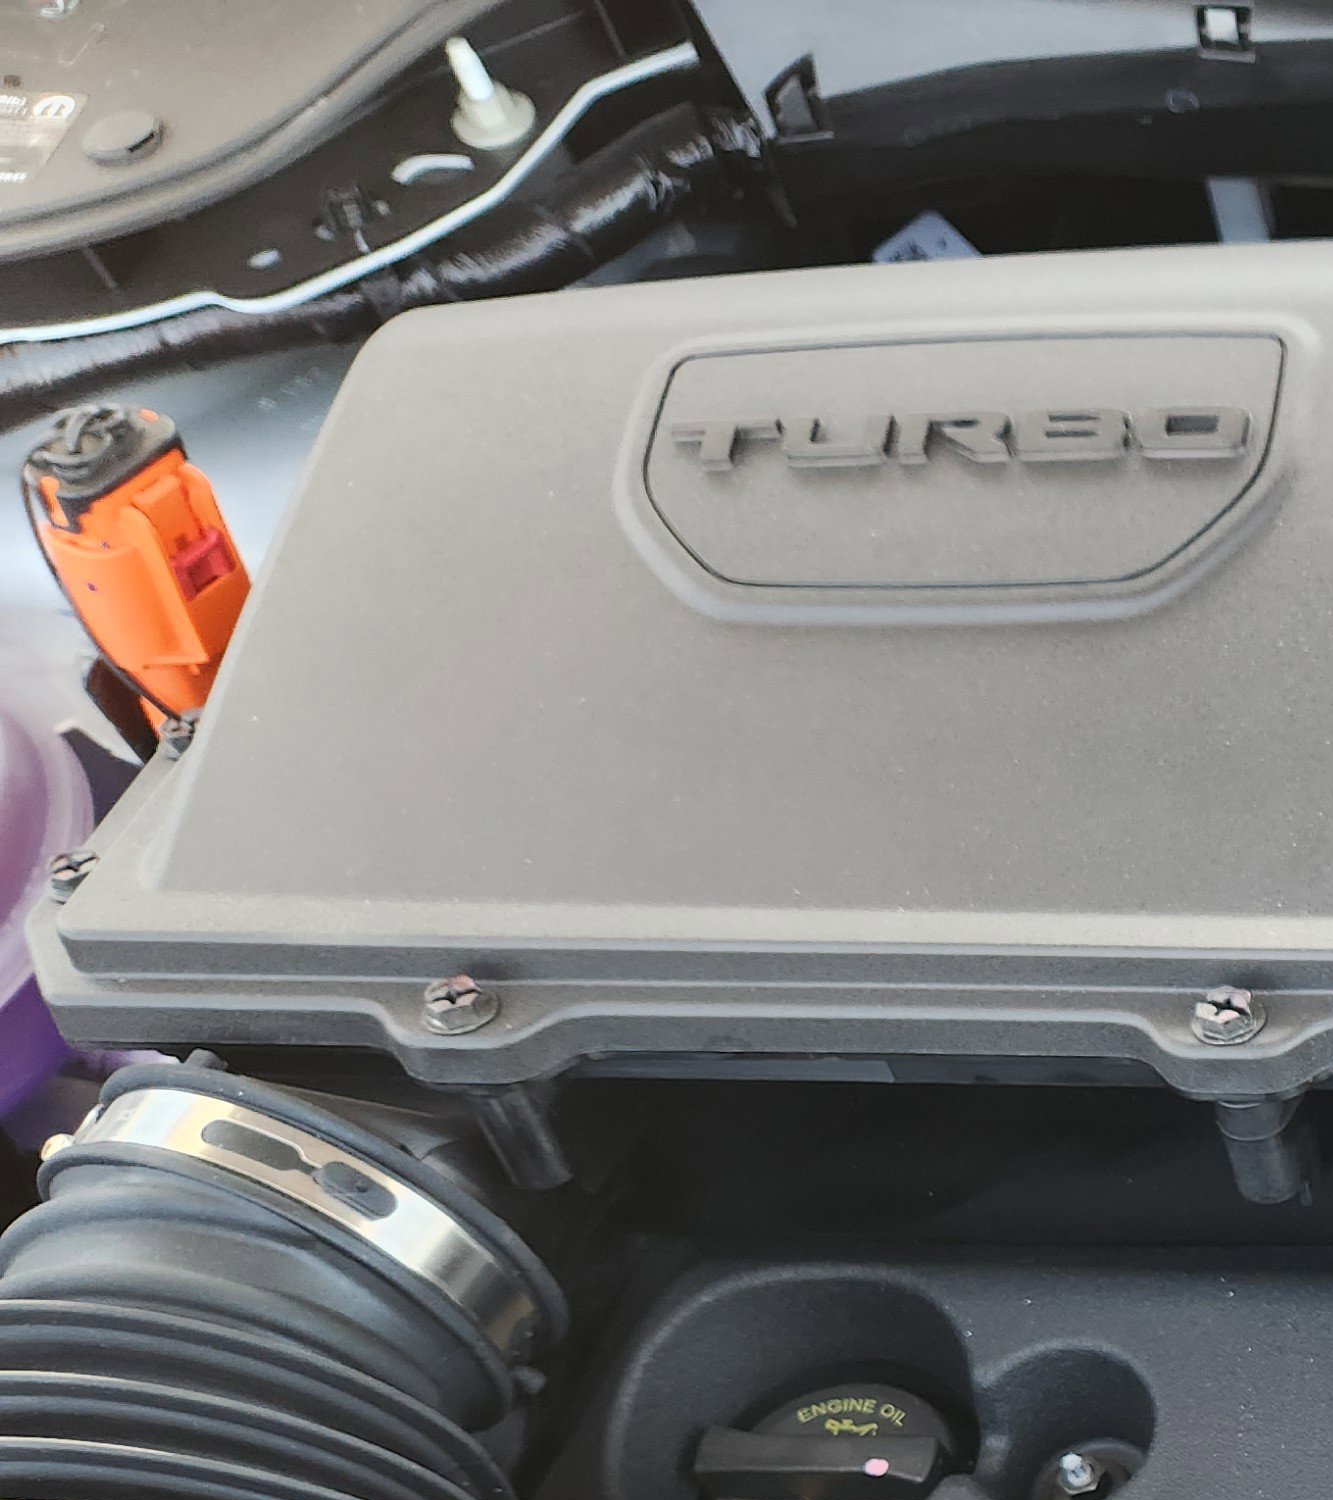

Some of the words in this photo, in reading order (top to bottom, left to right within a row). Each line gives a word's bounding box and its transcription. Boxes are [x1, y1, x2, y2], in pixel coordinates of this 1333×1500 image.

[671, 407, 1251, 474] TURBO
[797, 1398, 877, 1424] ENGINE
[880, 1404, 906, 1427] OIL
